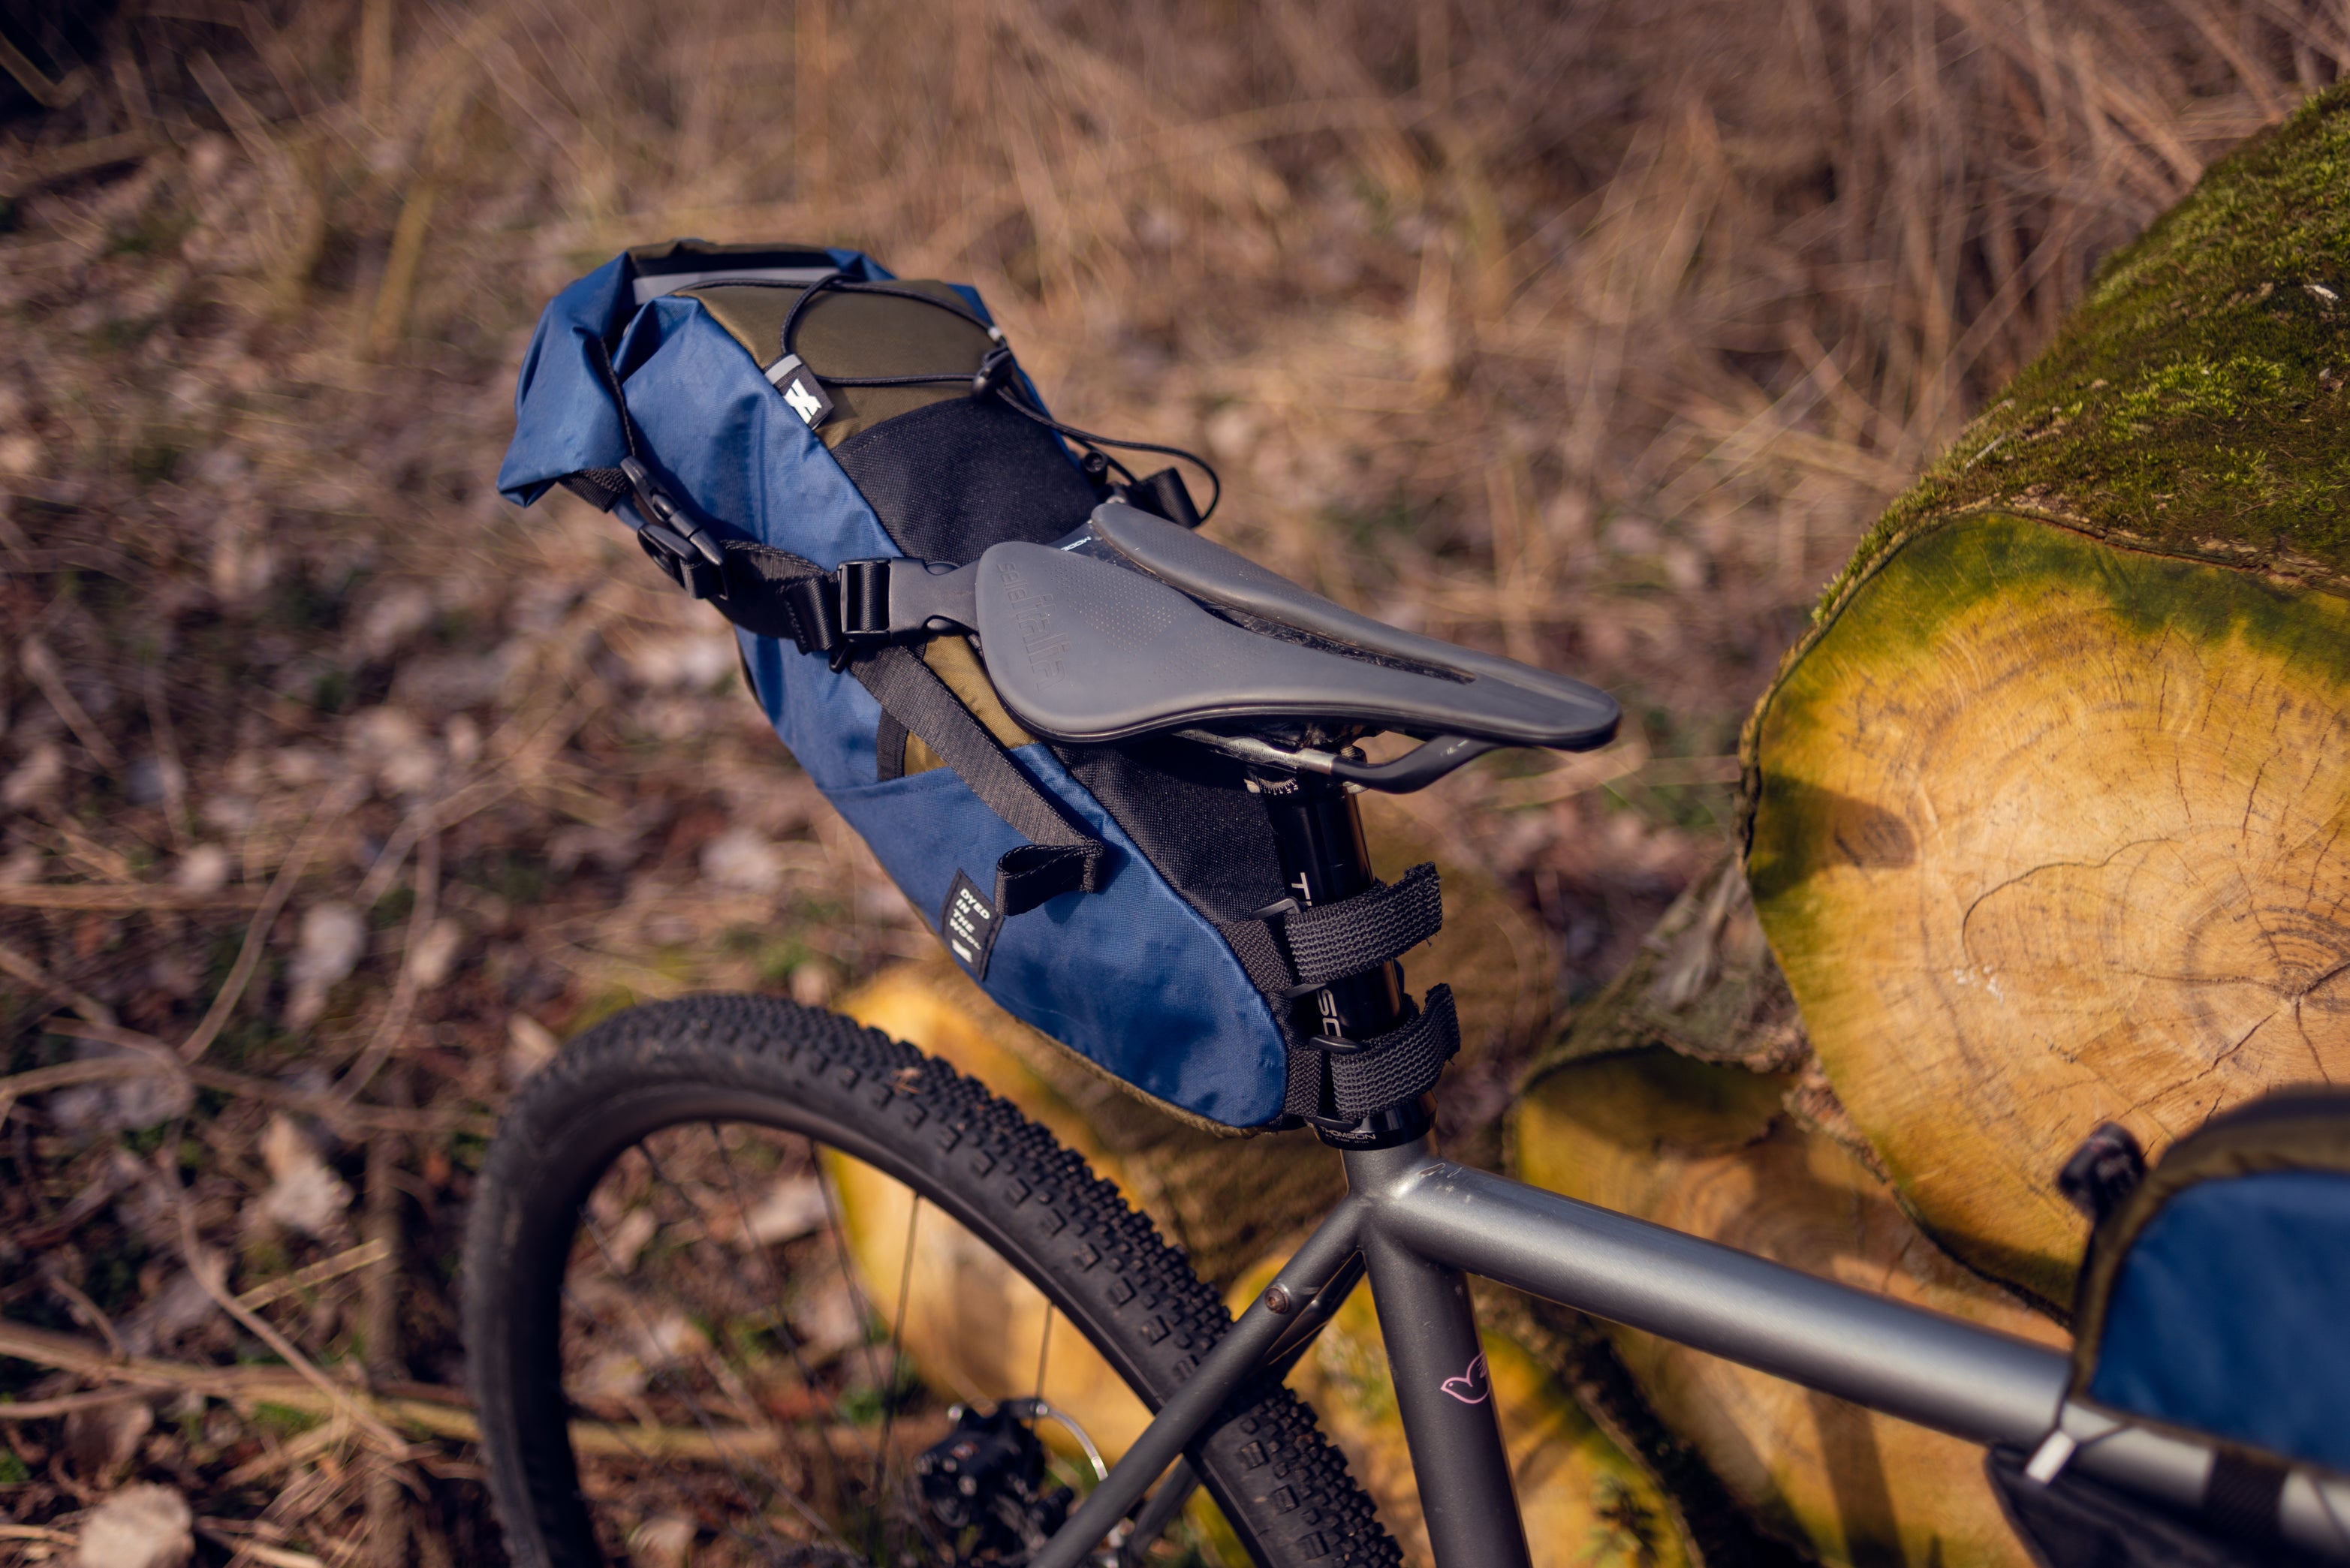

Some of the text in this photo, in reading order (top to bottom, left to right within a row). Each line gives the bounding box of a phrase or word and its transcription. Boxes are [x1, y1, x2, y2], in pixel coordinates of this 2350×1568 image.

[956, 898, 971, 914] IN
[960, 888, 990, 919] DYED
[953, 908, 975, 933] THE
[950, 917, 981, 950] WOOL
[1320, 1125, 1376, 1140] THOMSON
